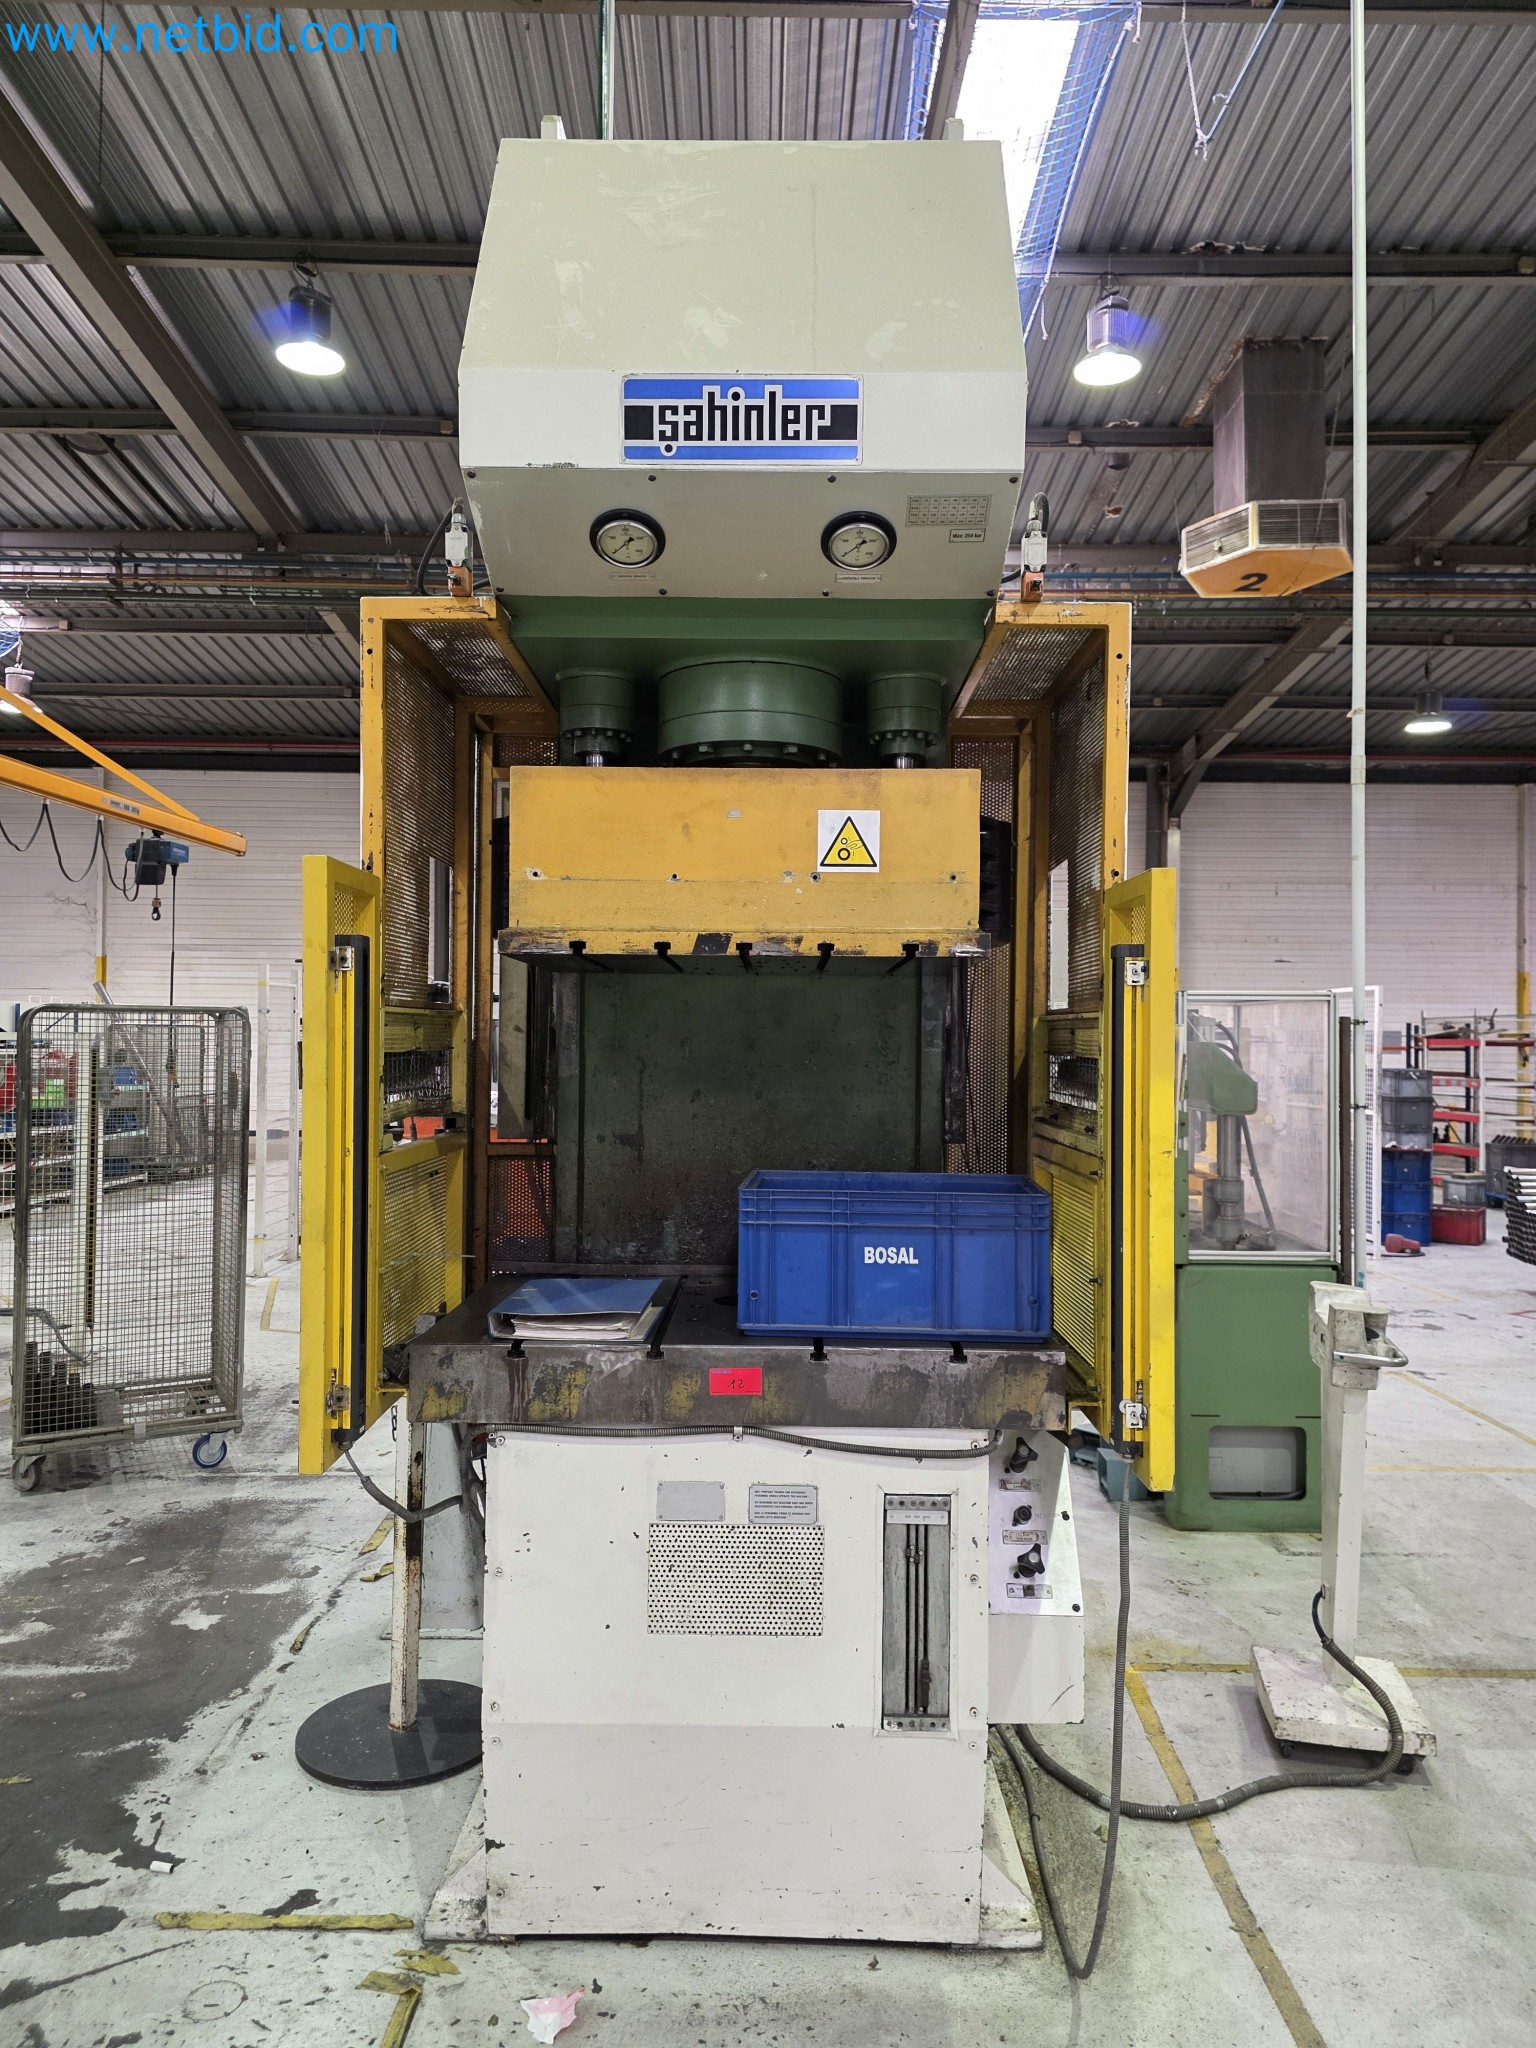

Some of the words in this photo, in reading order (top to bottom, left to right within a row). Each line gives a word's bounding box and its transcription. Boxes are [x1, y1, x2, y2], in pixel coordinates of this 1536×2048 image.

[1233, 572, 1269, 592] 2
[864, 1246, 919, 1265] BOSAL
[727, 1378, 745, 1390] 12
